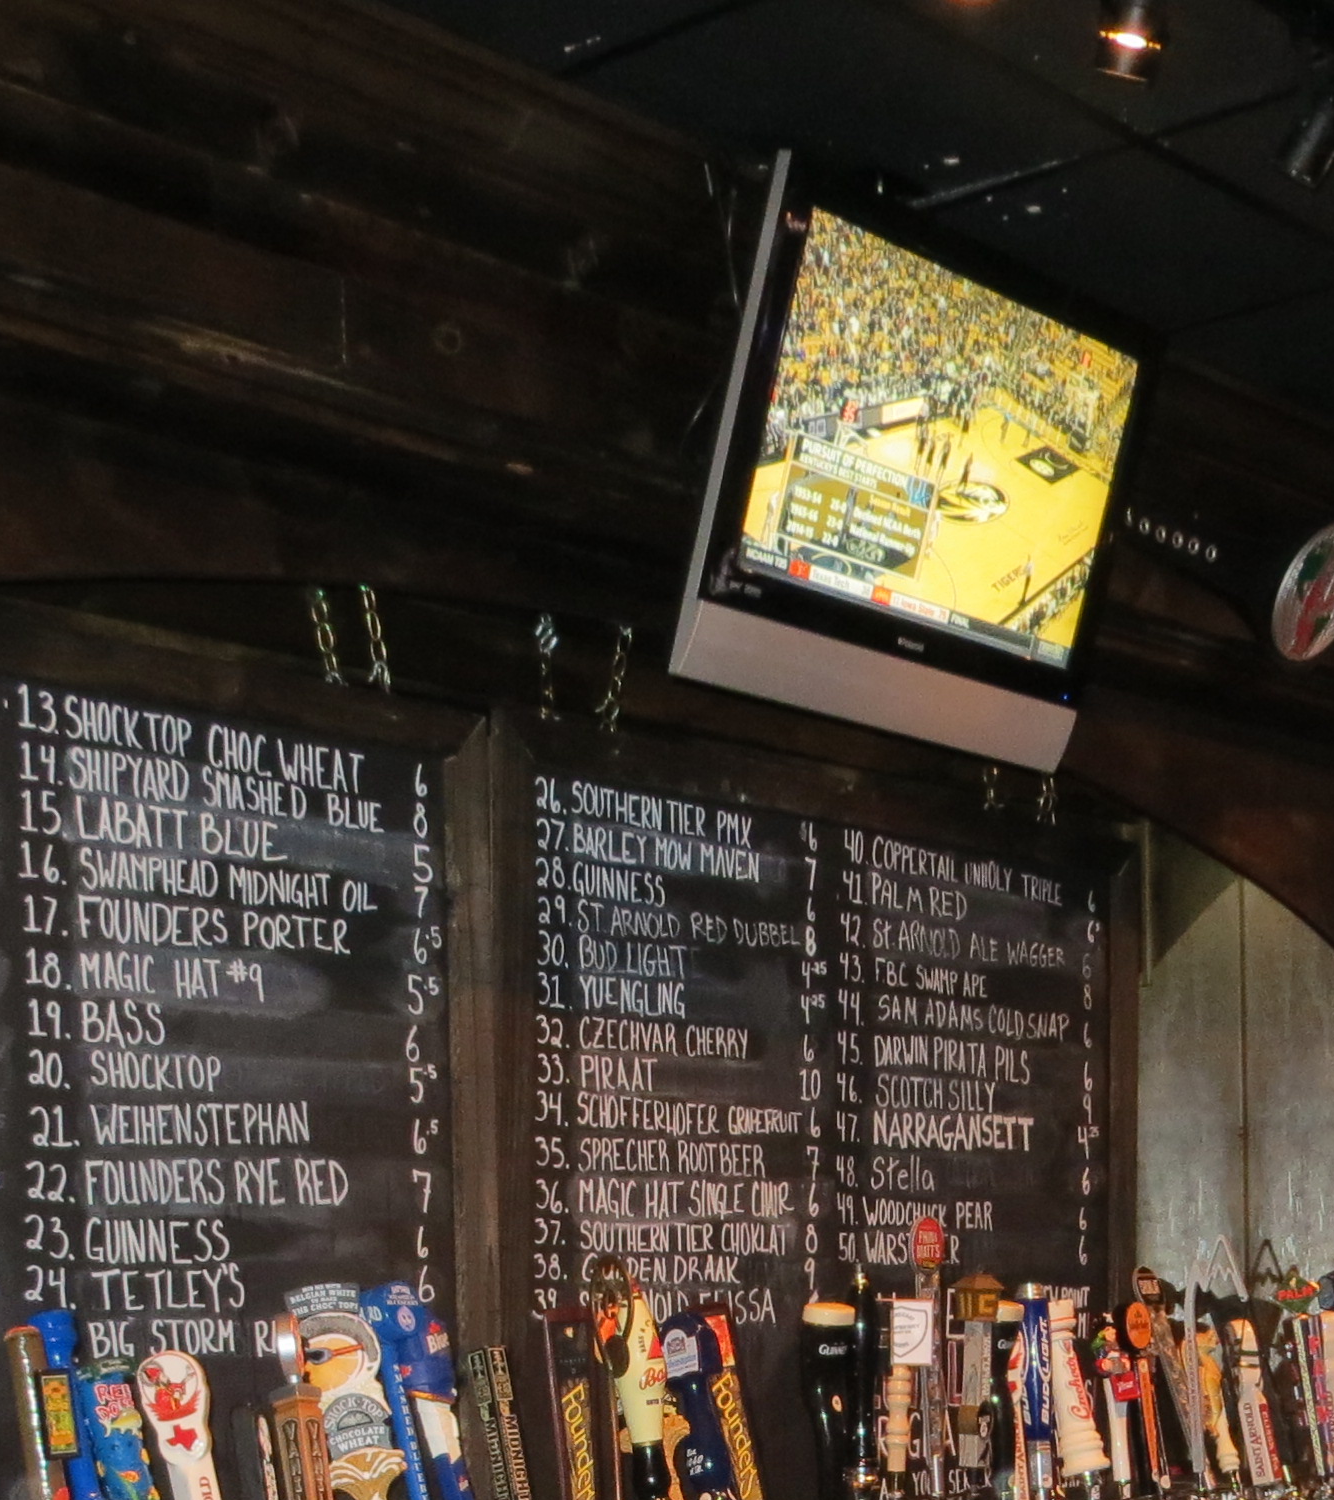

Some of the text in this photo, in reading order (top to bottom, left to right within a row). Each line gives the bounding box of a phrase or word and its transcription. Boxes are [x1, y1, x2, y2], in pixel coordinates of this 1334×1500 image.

[802, 438, 907, 486] PURSUIT OF PERFECTION
[68, 747, 189, 801] SHIPYARD
[571, 780, 706, 838] SOUTHERN TIER
[19, 790, 433, 884] 15. LABATT BLUE 5
[573, 823, 760, 883] BARLEY MOW MAVEN
[872, 834, 959, 884] COPPERTAIL
[573, 861, 665, 908] GUINNESS
[78, 895, 351, 955] FOUNDERS PORTER
[80, 952, 220, 1000] MAGIC HAT
[579, 975, 685, 1019] YUENGLING
[81, 1000, 166, 1046] BASS
[877, 993, 983, 1031] SAM ADAMS
[580, 1054, 820, 1101] PIRAAT 10
[88, 1101, 310, 1147] WEIHENSTEPHAN
[872, 1109, 1034, 1151] NARRAGANSETT
[25, 1158, 349, 1207] 22. FOUNDERS RYE RED
[870, 1154, 935, 1192] Stella
[85, 1219, 230, 1265] GUINNESS
[91, 1262, 246, 1310] TETLEY'S
[87, 1319, 236, 1359] BIG STORM
[426, 1332, 451, 1354] Blue
[1038, 1316, 1053, 1425] BUD LIGHT
[329, 1425, 386, 1447] CHOCOLATE
[337, 1435, 380, 1452] WHEAT
[711, 1371, 759, 1500] Founders
[1242, 1402, 1265, 1477] SAINT ARNOLD
